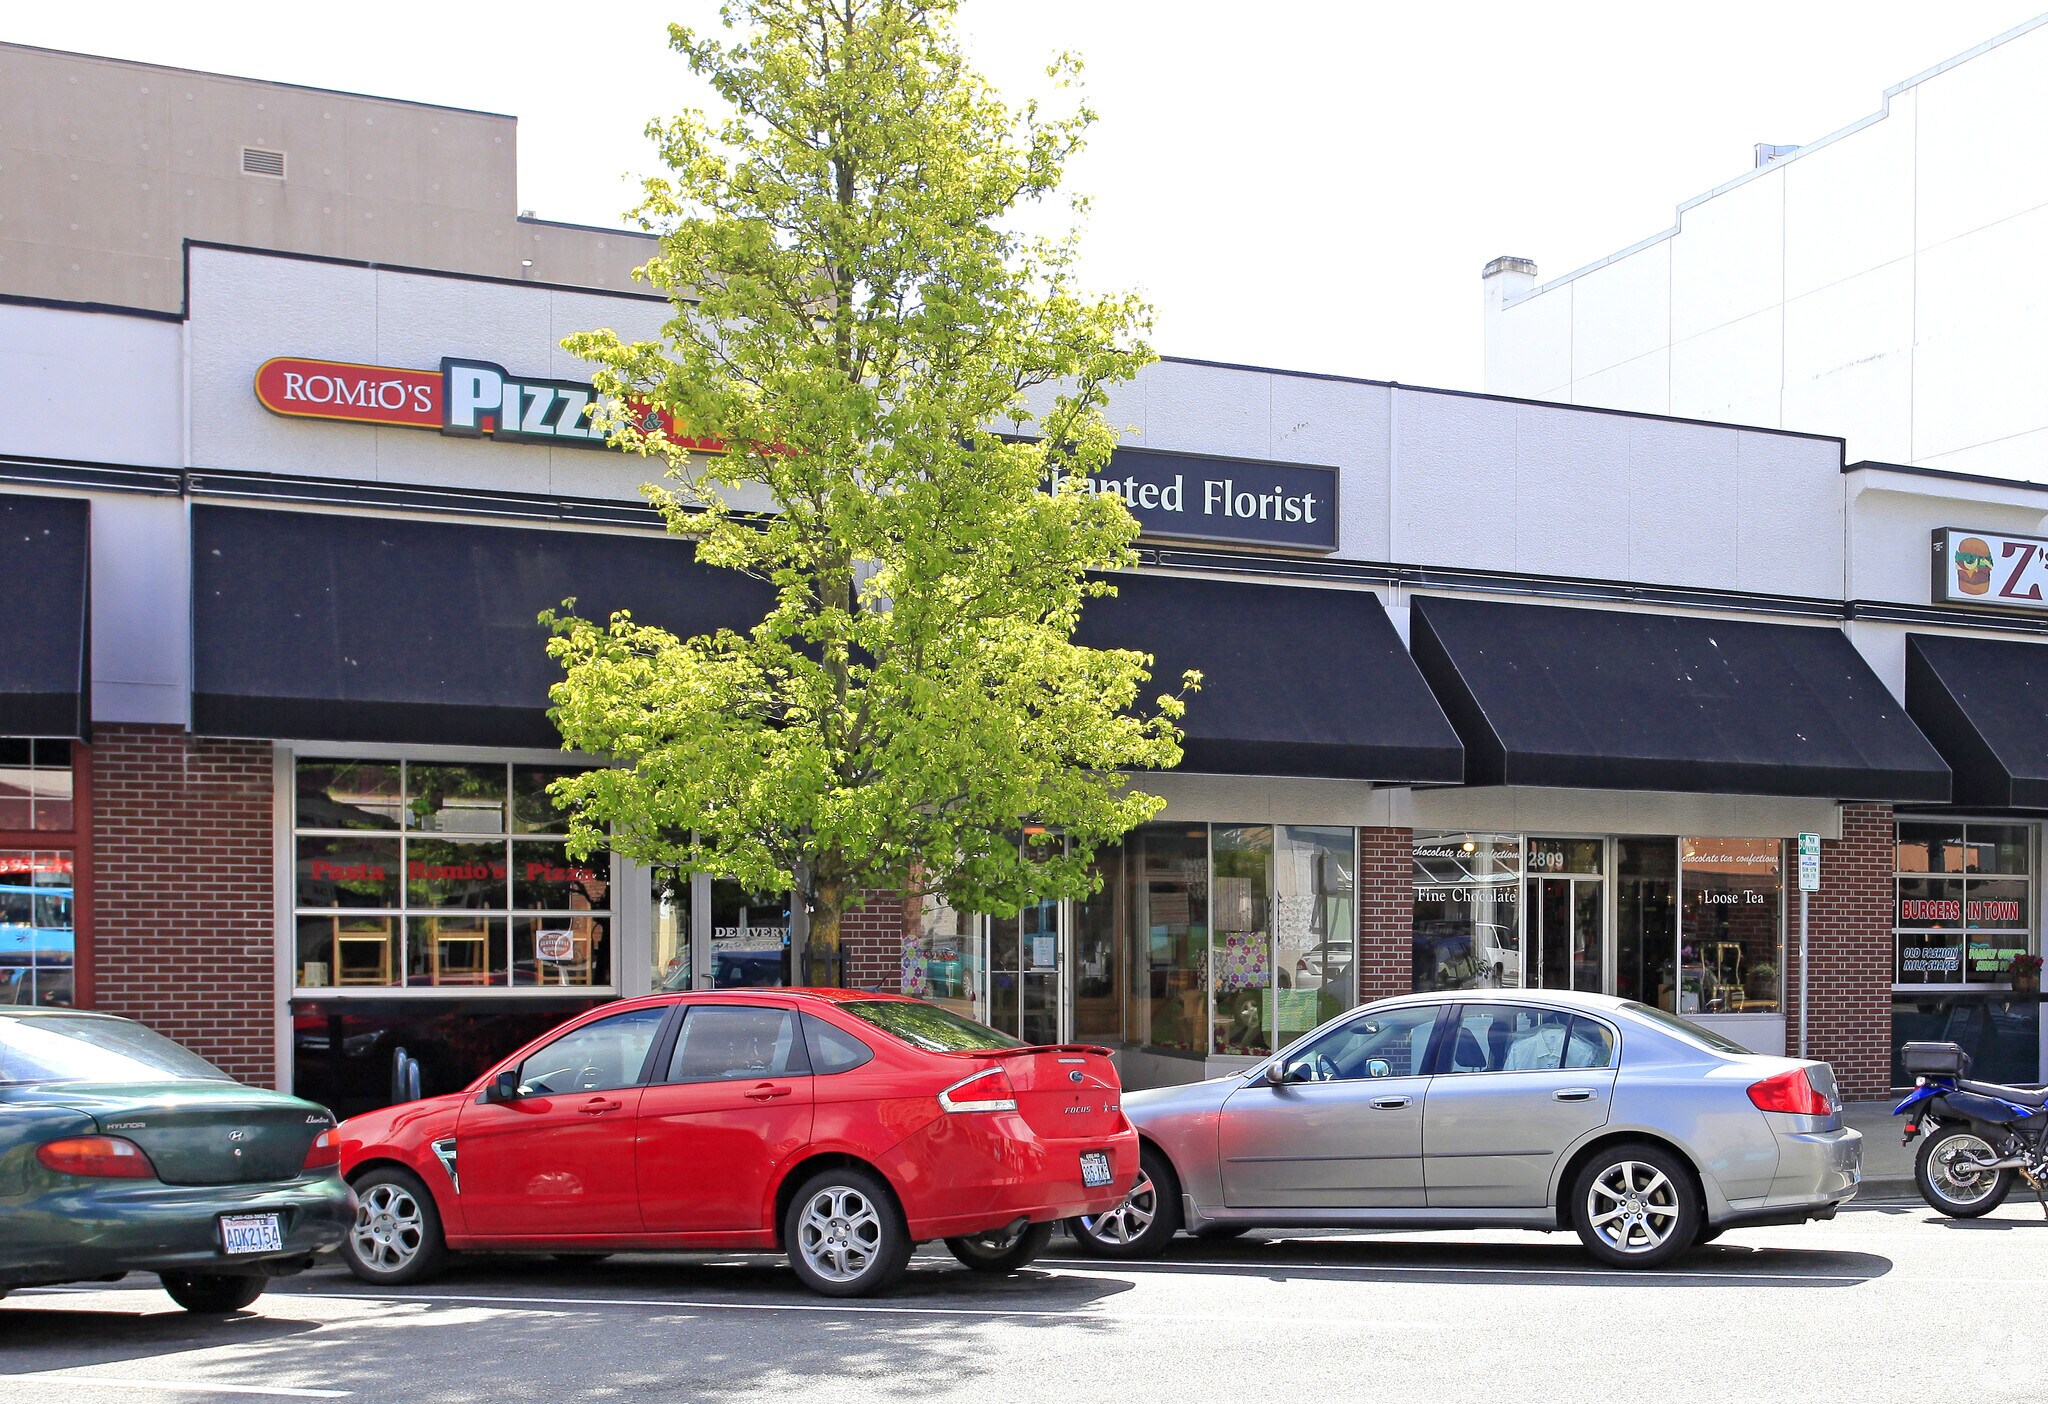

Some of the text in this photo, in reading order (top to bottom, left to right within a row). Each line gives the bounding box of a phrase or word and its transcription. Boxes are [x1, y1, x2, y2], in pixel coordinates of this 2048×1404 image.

[642, 412, 663, 431] &
[1204, 480, 1317, 524] Florist
[1412, 845, 1454, 858] chocolate
[1456, 850, 1471, 858] tea
[1528, 851, 1564, 867] 2809
[1682, 853, 1778, 866] chocolate tea confections
[311, 860, 386, 881] Pasta
[408, 860, 506, 880] Romio's
[1417, 887, 1516, 903] Fine Chocolate
[1704, 889, 1764, 904] Loose Tea
[1902, 900, 1960, 920] BURGERS
[1968, 901, 2018, 920] IN TOWN
[714, 927, 790, 937] DELIVERY
[1903, 947, 1958, 959] OLD FASHION
[1903, 959, 1959, 971] MILK SHAKES
[1064, 1106, 1091, 1114] FOCUS
[107, 1122, 146, 1130] HYUNDAI
[226, 1226, 279, 1248] ADK2154
